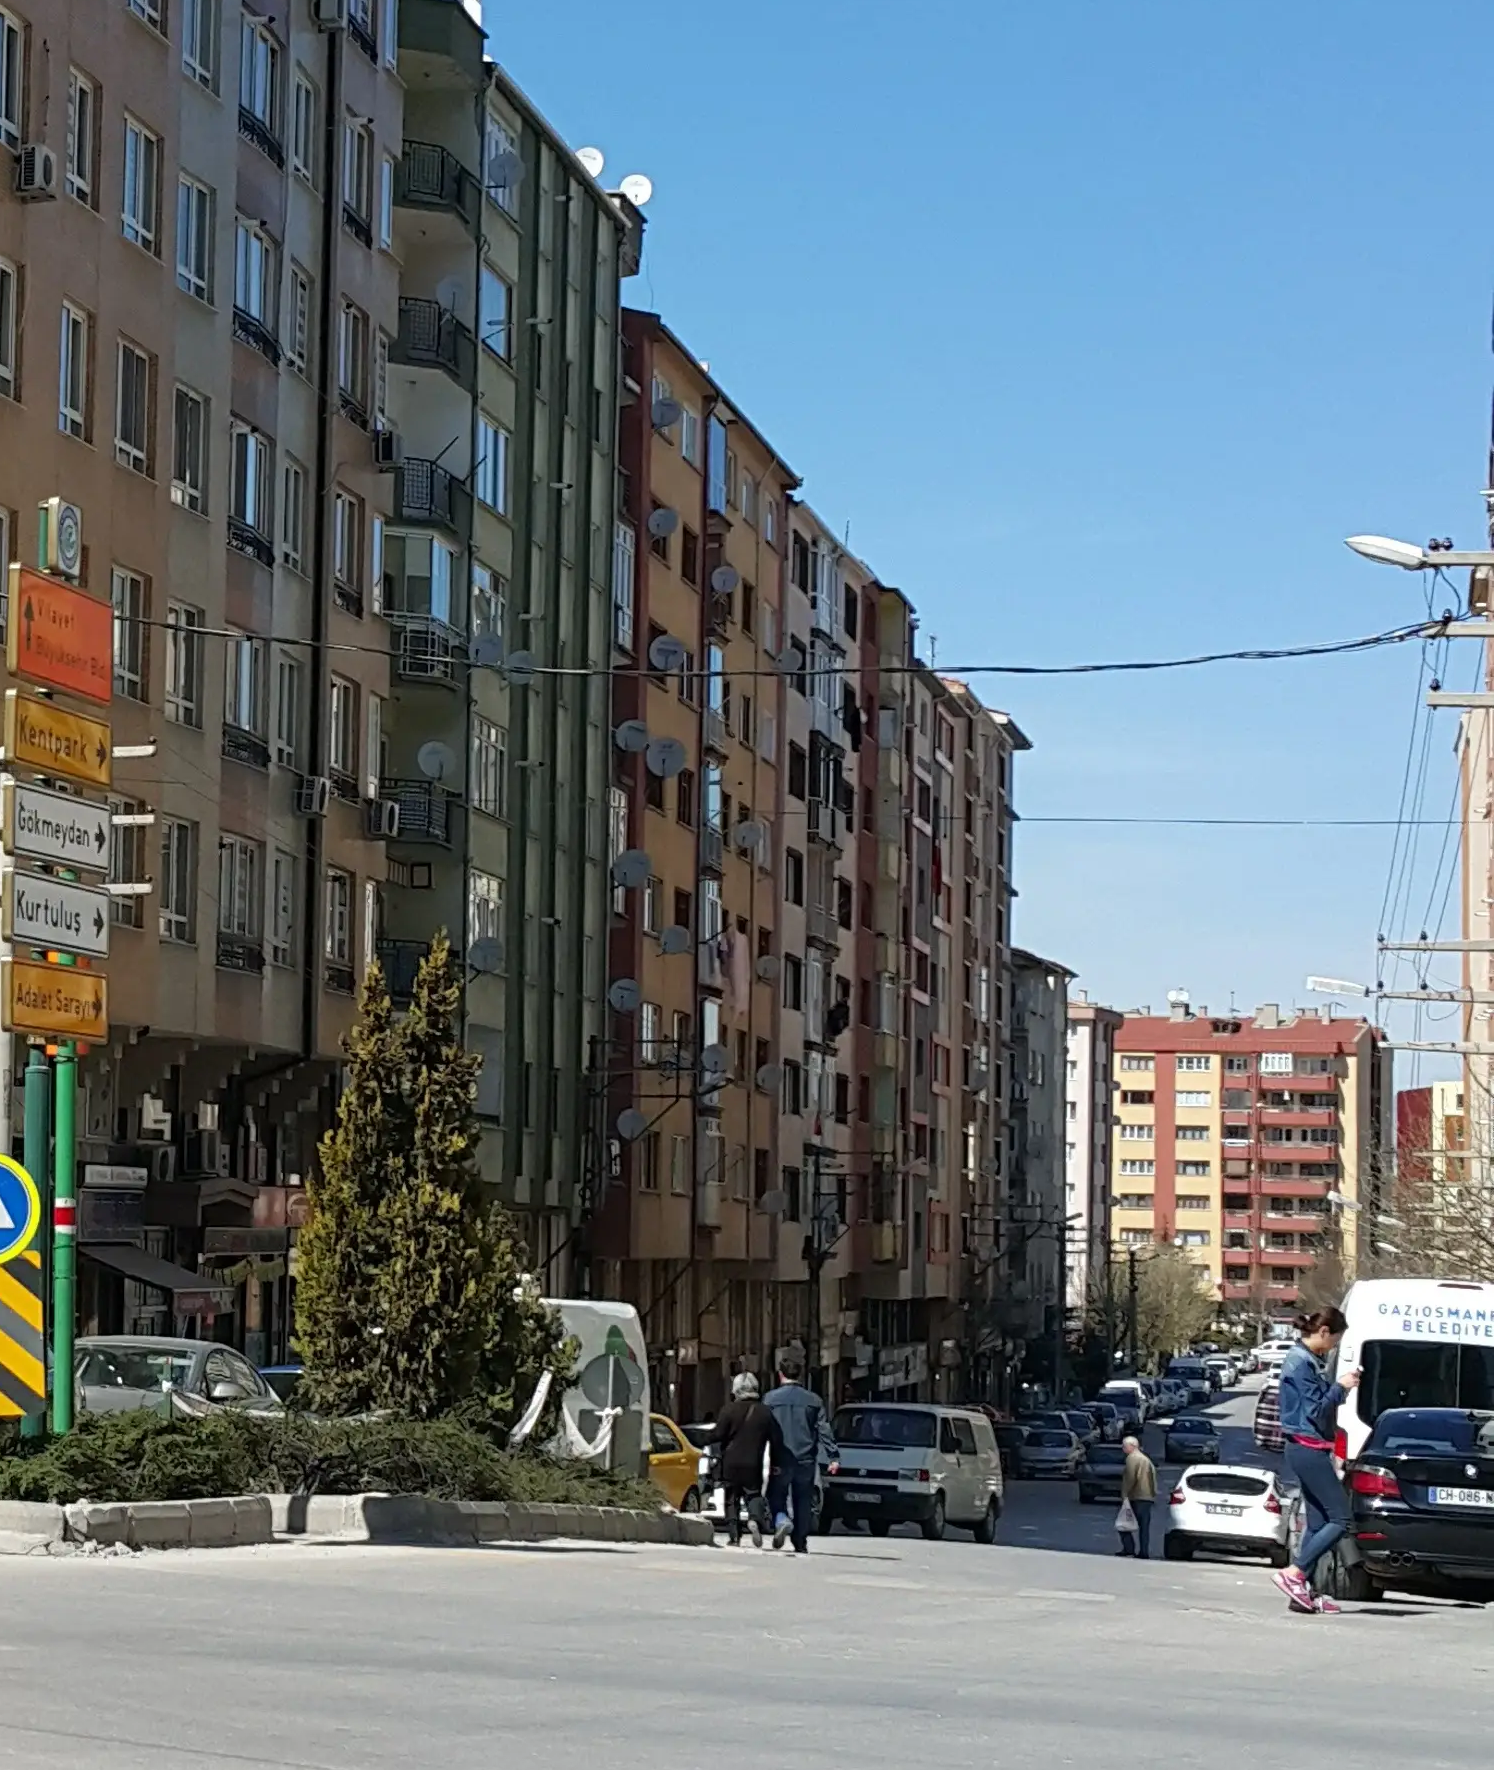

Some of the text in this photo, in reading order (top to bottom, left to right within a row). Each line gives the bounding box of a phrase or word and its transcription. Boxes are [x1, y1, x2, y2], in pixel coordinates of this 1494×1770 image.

[18, 713, 88, 763] Kentpark
[17, 806, 91, 849] Gökmeydan
[16, 889, 82, 937] Kurtuluş
[16, 982, 91, 1022] Adalet Sarayı
